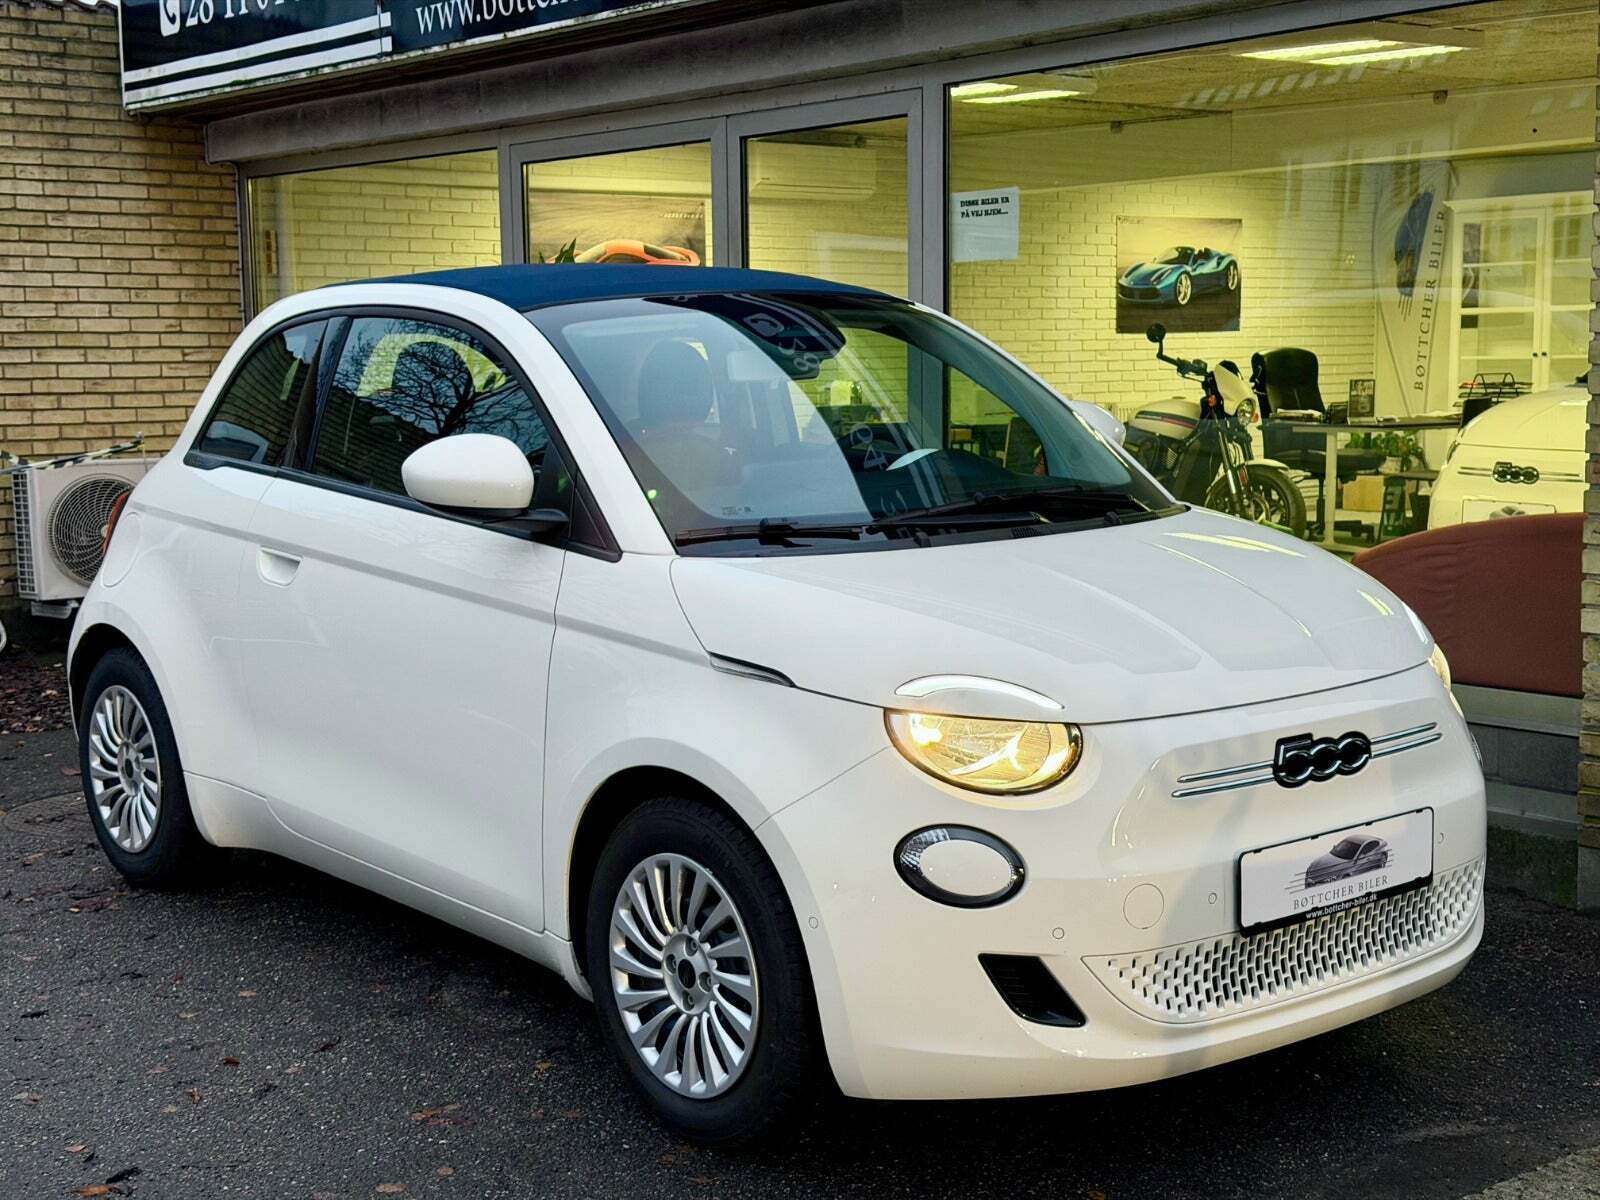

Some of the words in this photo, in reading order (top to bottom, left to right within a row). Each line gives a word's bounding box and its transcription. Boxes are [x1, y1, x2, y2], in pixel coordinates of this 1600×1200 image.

[981, 197, 999, 206] BILER
[961, 210, 970, 218] PÅ
[971, 209, 983, 217] VEJ
[1414, 279, 1437, 391] BØTTCHER
[1273, 731, 1372, 788] 500
[1358, 875, 1388, 892] BILER
